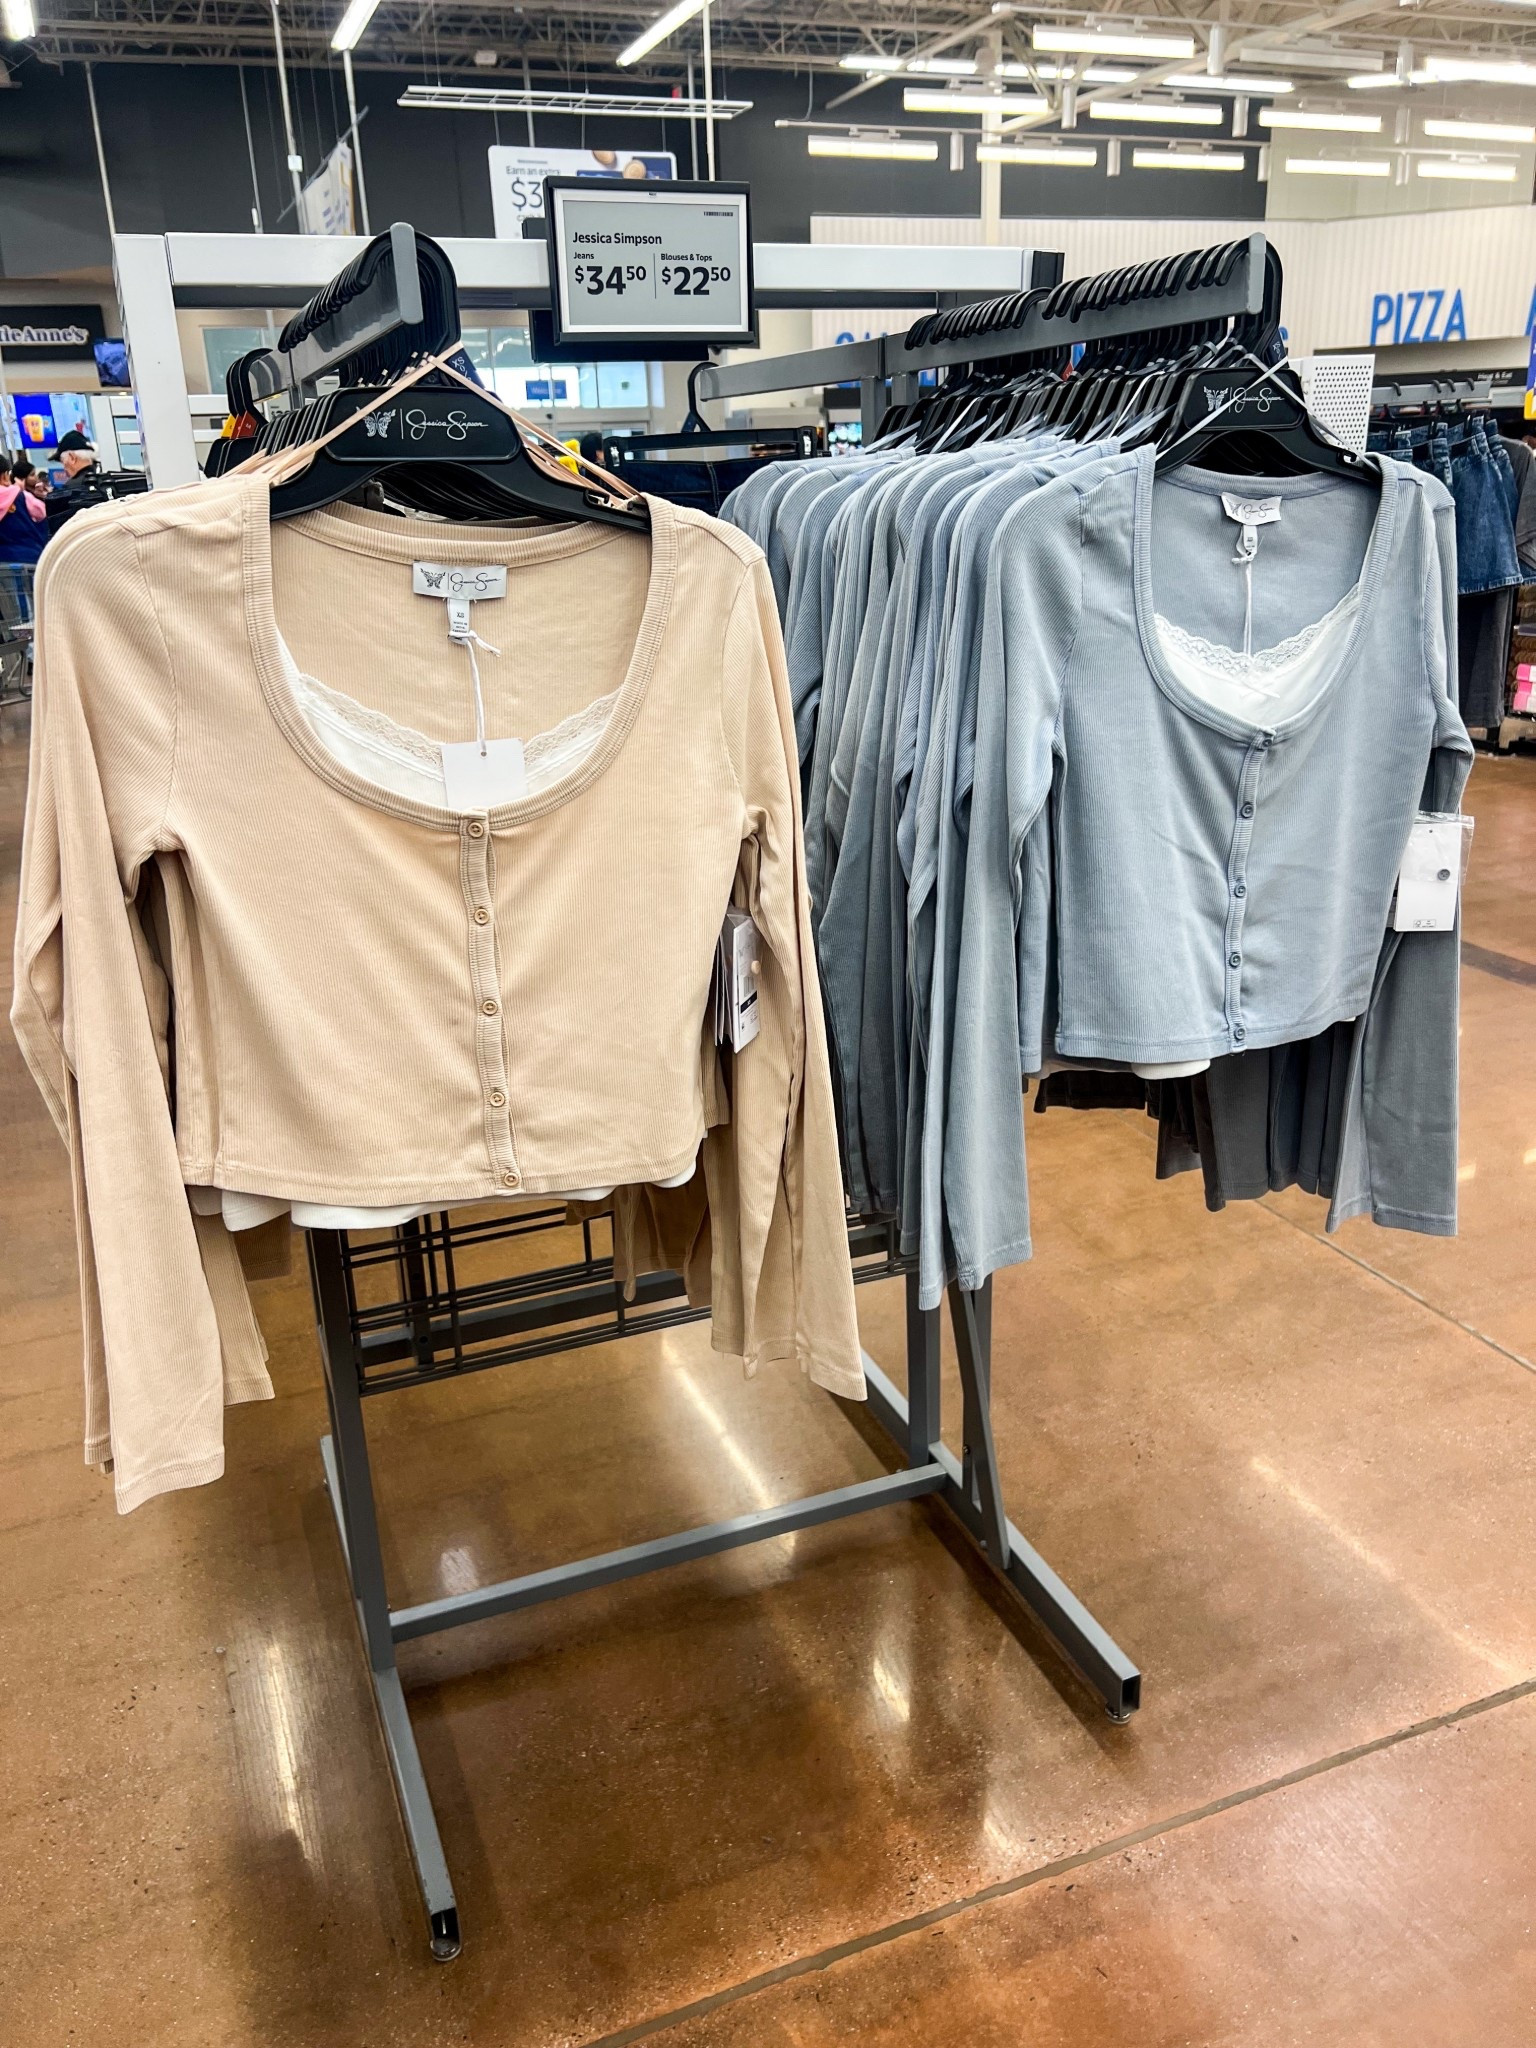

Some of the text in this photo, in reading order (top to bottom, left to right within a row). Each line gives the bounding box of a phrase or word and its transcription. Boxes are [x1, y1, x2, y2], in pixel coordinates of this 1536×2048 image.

[506, 165, 527, 175] Earn
[572, 231, 662, 246] Jessica Simpson
[573, 252, 595, 260] Jeans
[660, 253, 689, 261] Blouses
[696, 254, 713, 262] Tops
[1370, 288, 1467, 346] PIZZA
